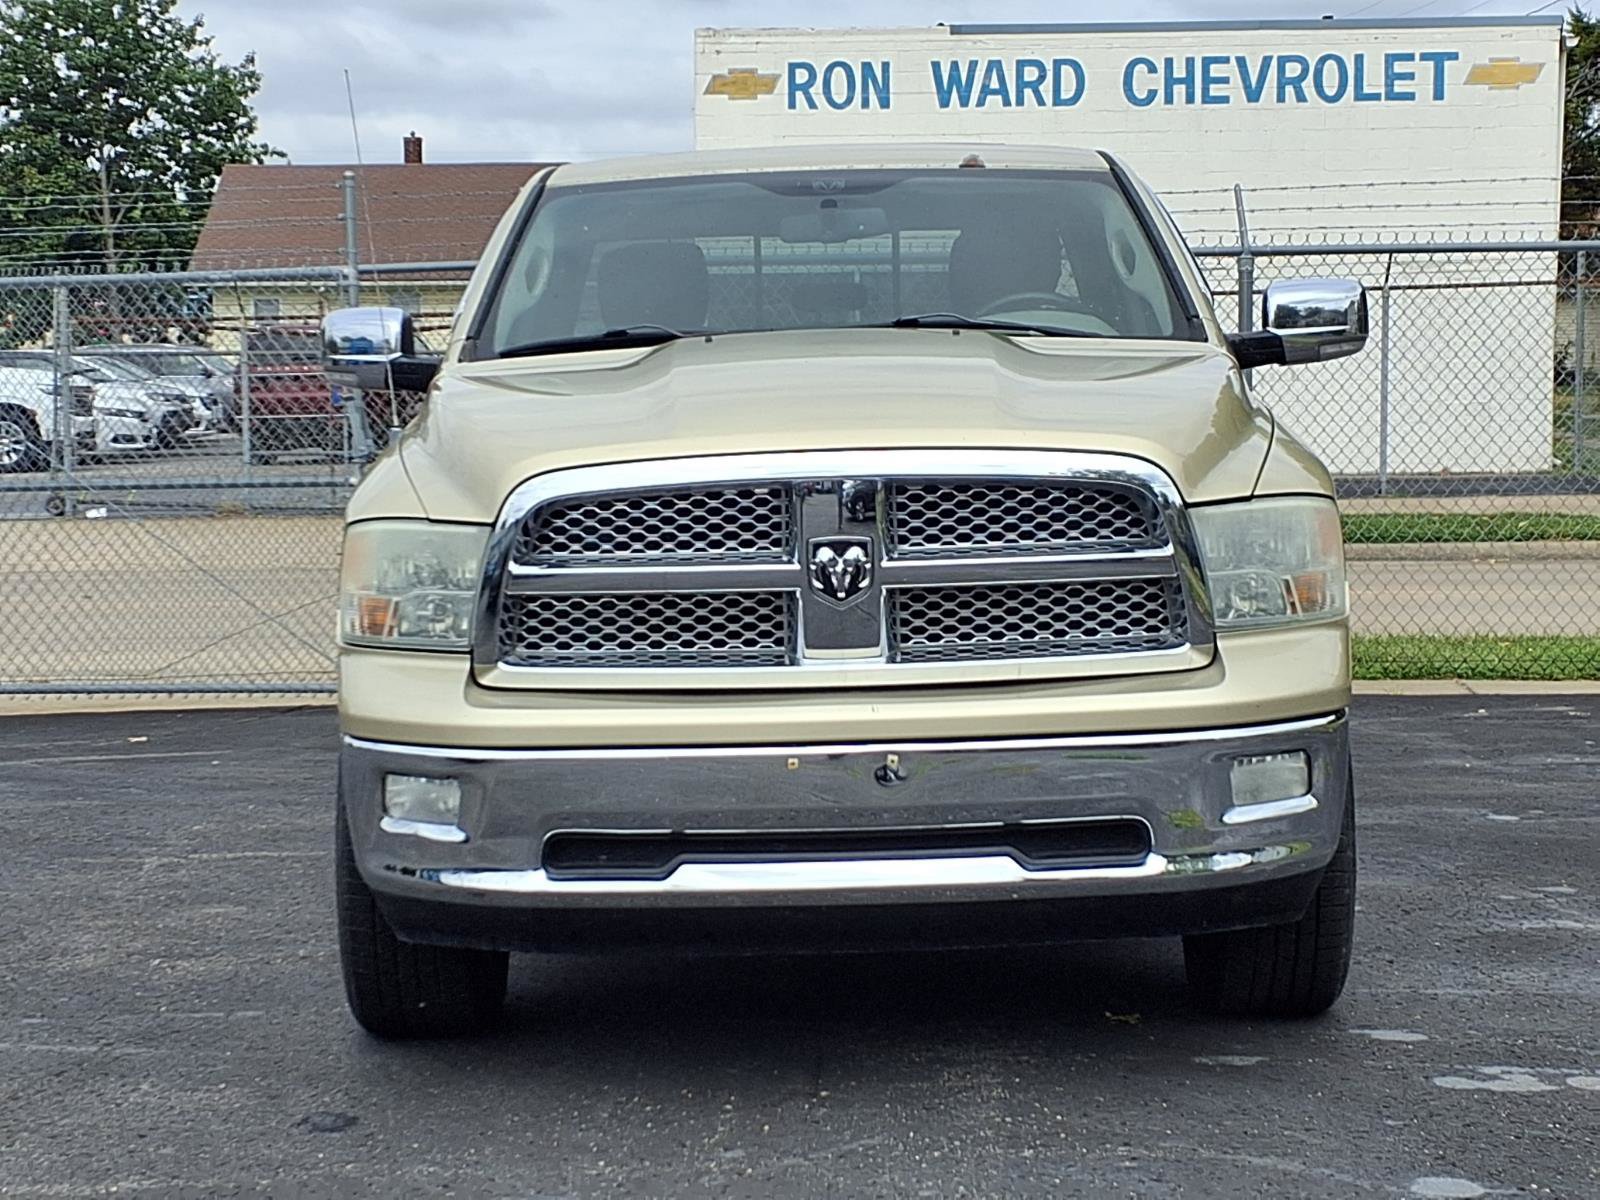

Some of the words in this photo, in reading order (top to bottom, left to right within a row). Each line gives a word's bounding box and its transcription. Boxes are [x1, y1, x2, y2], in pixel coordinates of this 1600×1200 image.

[786, 60, 892, 110] RON
[930, 57, 1088, 108] WARD
[1122, 50, 1461, 107] CHEVROLET
